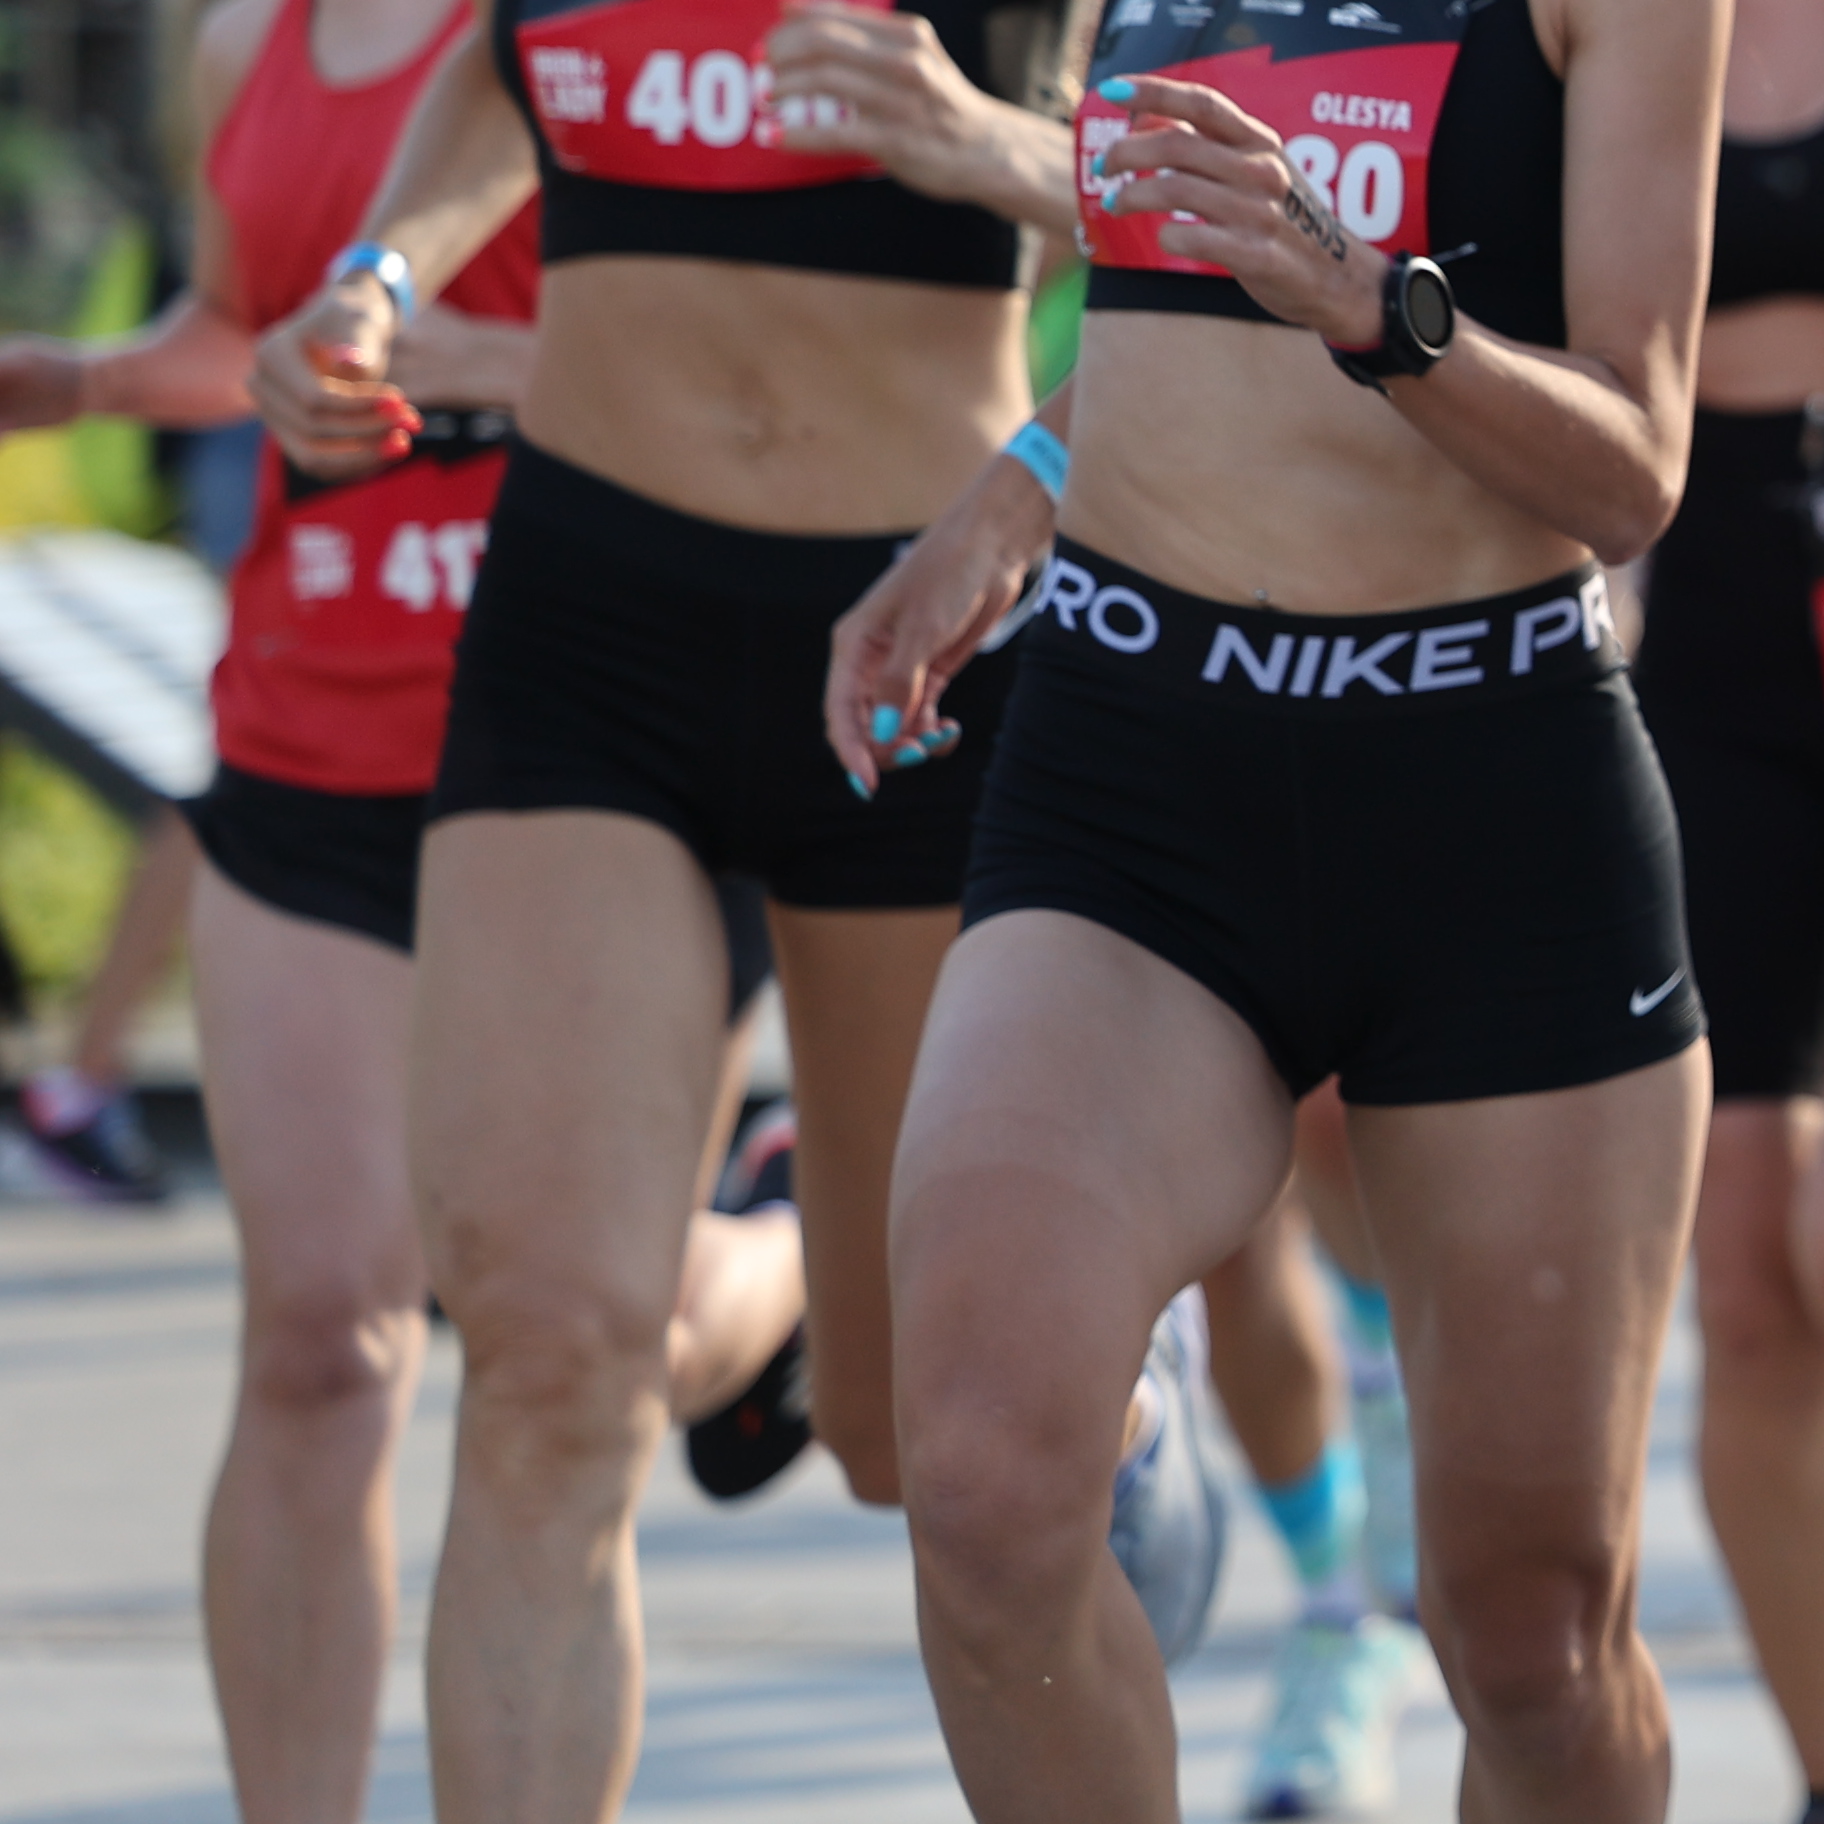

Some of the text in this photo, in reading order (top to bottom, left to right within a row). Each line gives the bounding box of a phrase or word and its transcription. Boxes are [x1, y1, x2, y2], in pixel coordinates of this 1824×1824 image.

[1311, 91, 1412, 132] OLESYA
[1200, 622, 1490, 699] NIKE
[1509, 572, 1616, 676] PR
